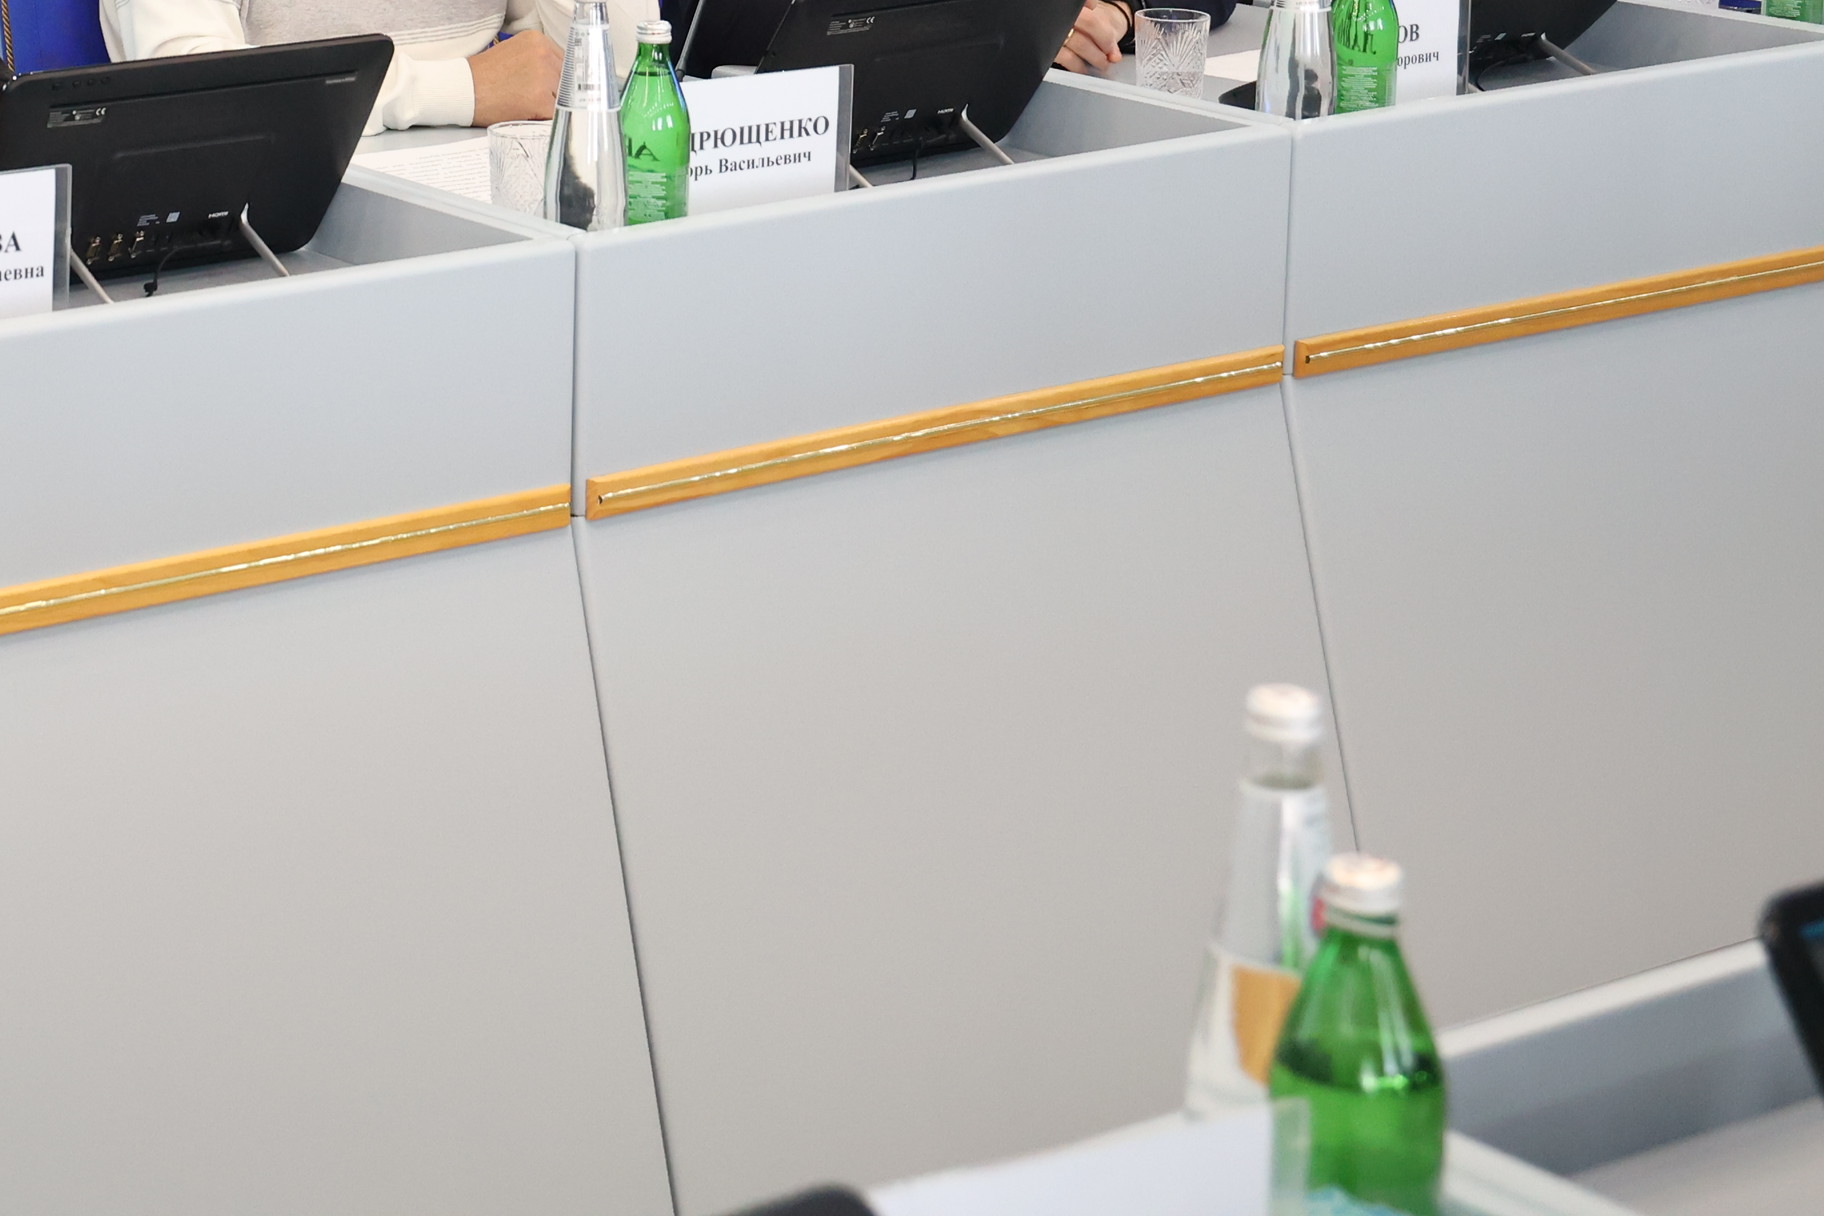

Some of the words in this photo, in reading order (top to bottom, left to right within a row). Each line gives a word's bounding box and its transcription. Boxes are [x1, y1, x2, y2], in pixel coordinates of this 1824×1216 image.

[1398, 23, 1420, 44] ОВ
[1397, 51, 1439, 70] орович
[719, 150, 812, 174] Васильевич
